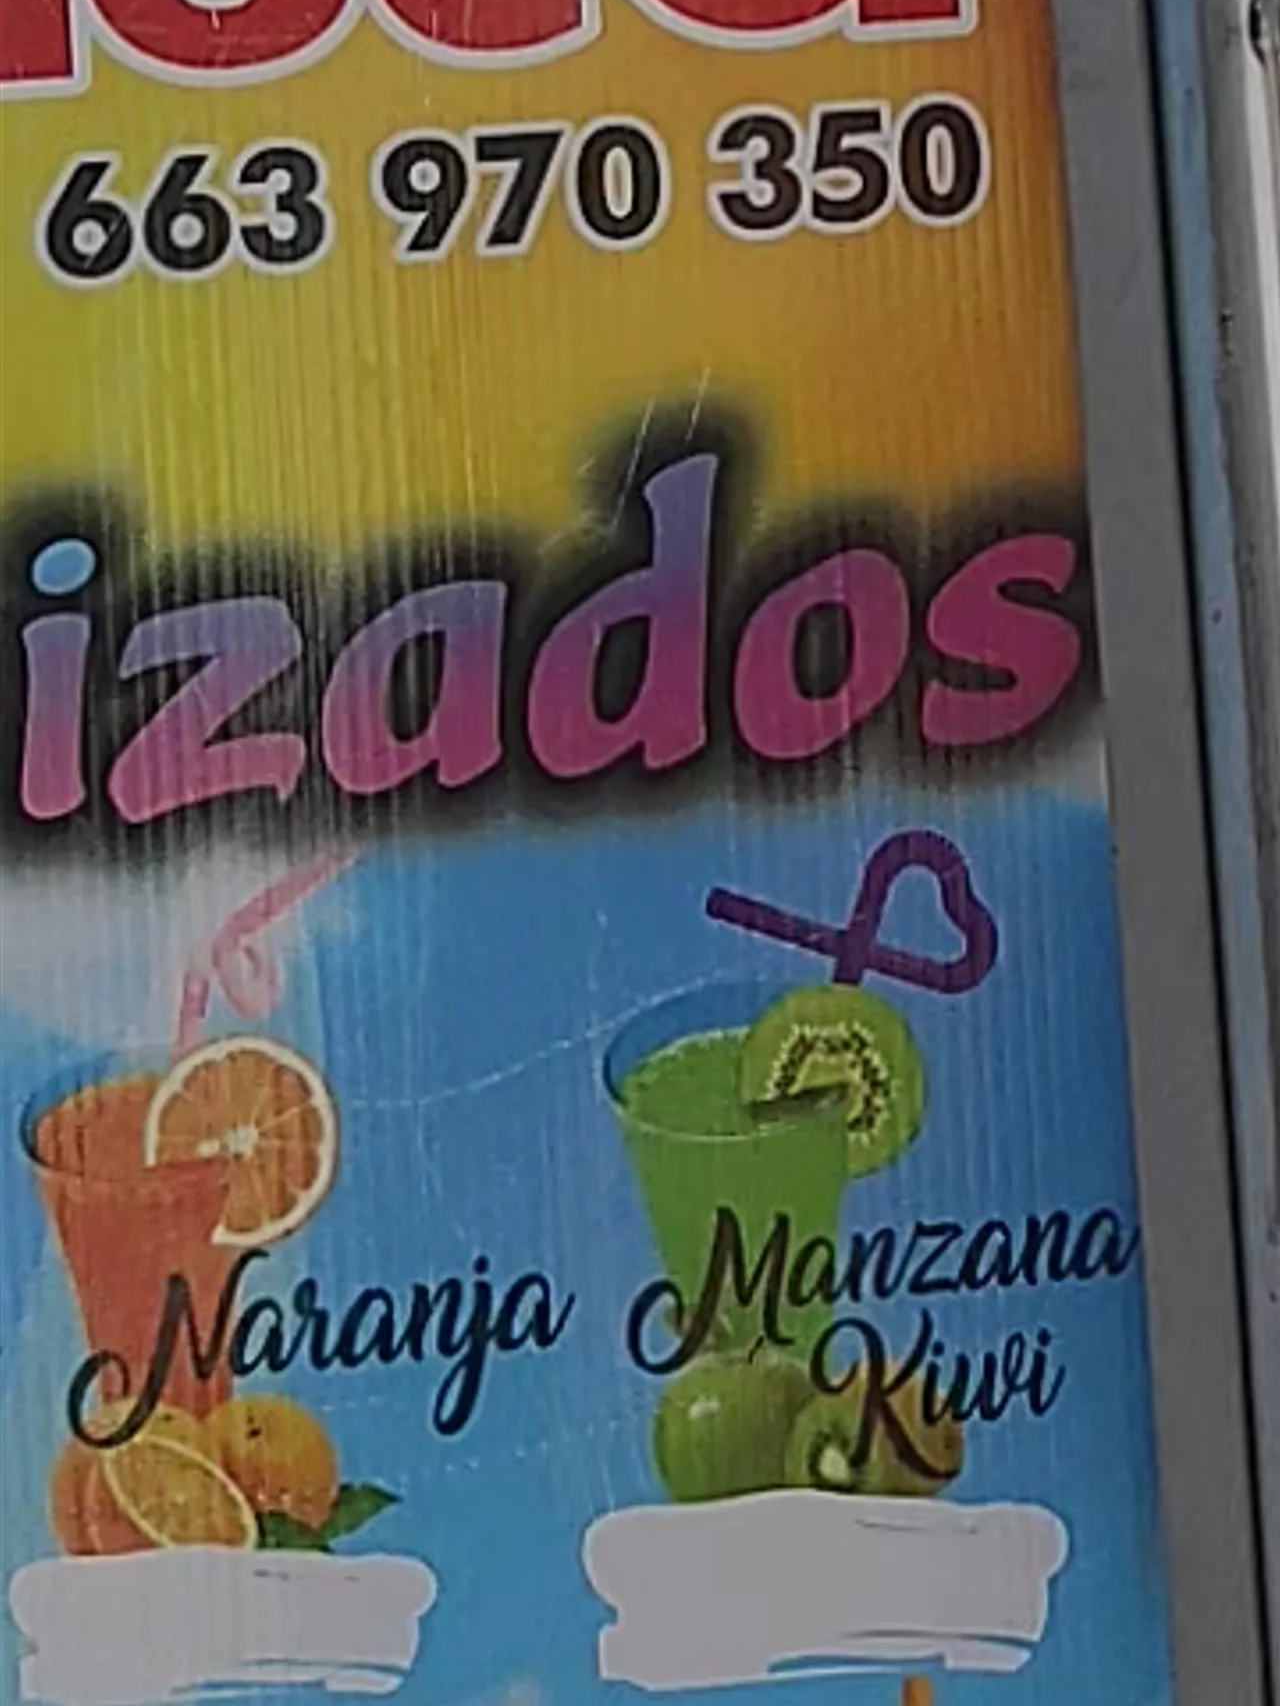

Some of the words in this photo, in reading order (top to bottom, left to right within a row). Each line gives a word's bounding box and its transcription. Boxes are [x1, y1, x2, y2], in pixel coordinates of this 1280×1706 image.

[44, 144, 328, 280] 663
[381, 124, 663, 253] 970
[715, 101, 984, 231] 350
[20, 452, 1081, 825] izados
[66, 1248, 577, 1451] Naranja
[626, 1205, 1140, 1376] Manzana
[809, 1307, 1067, 1481] Kiwi
